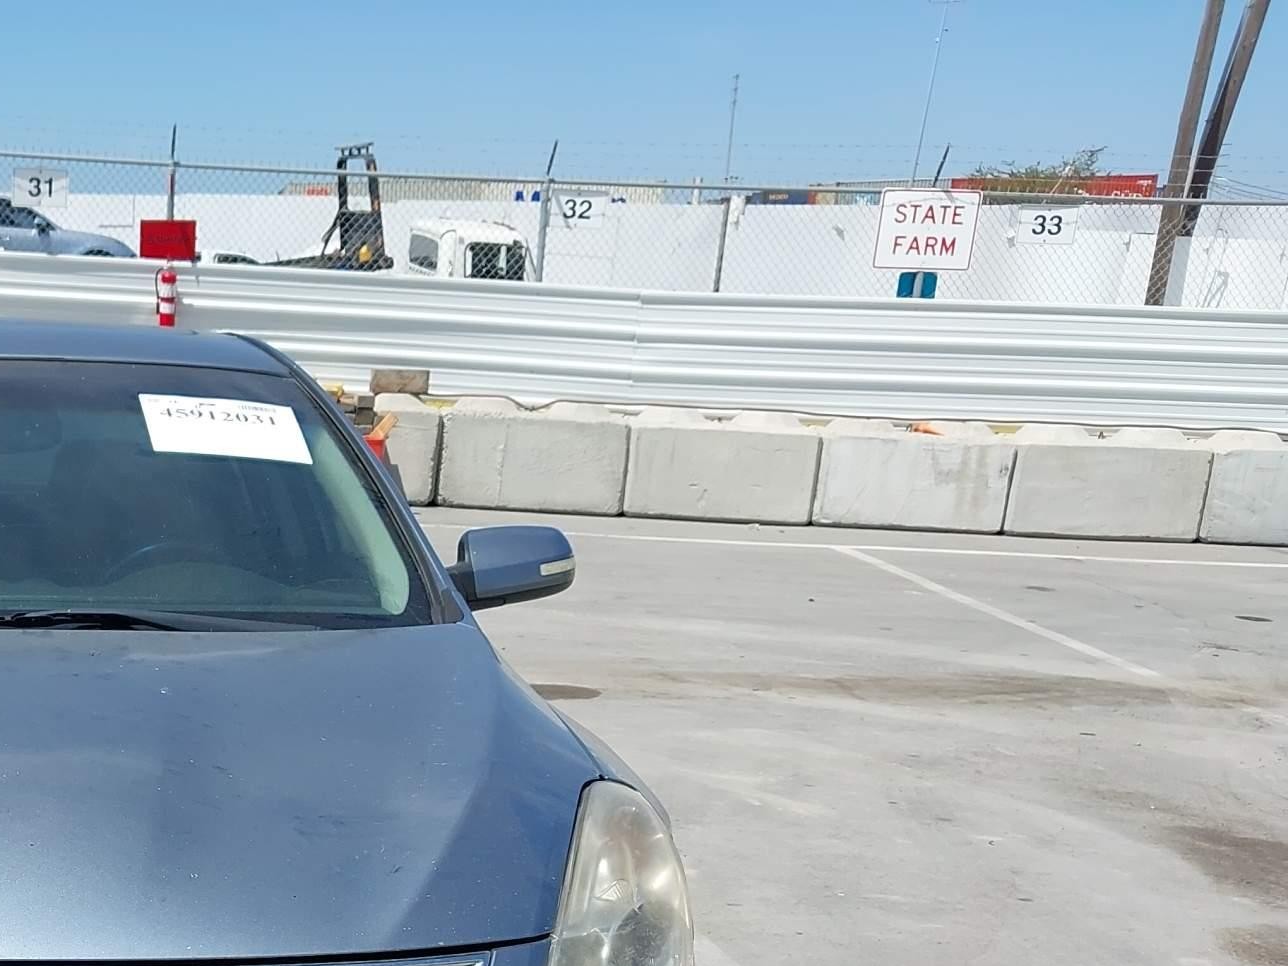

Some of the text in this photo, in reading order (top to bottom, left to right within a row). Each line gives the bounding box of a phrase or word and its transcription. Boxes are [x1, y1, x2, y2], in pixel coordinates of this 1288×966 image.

[28, 177, 53, 198] 31
[562, 199, 592, 220] 32
[895, 203, 965, 225] STATE
[1031, 214, 1063, 236] 33
[892, 235, 957, 257] FARM
[160, 407, 276, 425] 45912031
